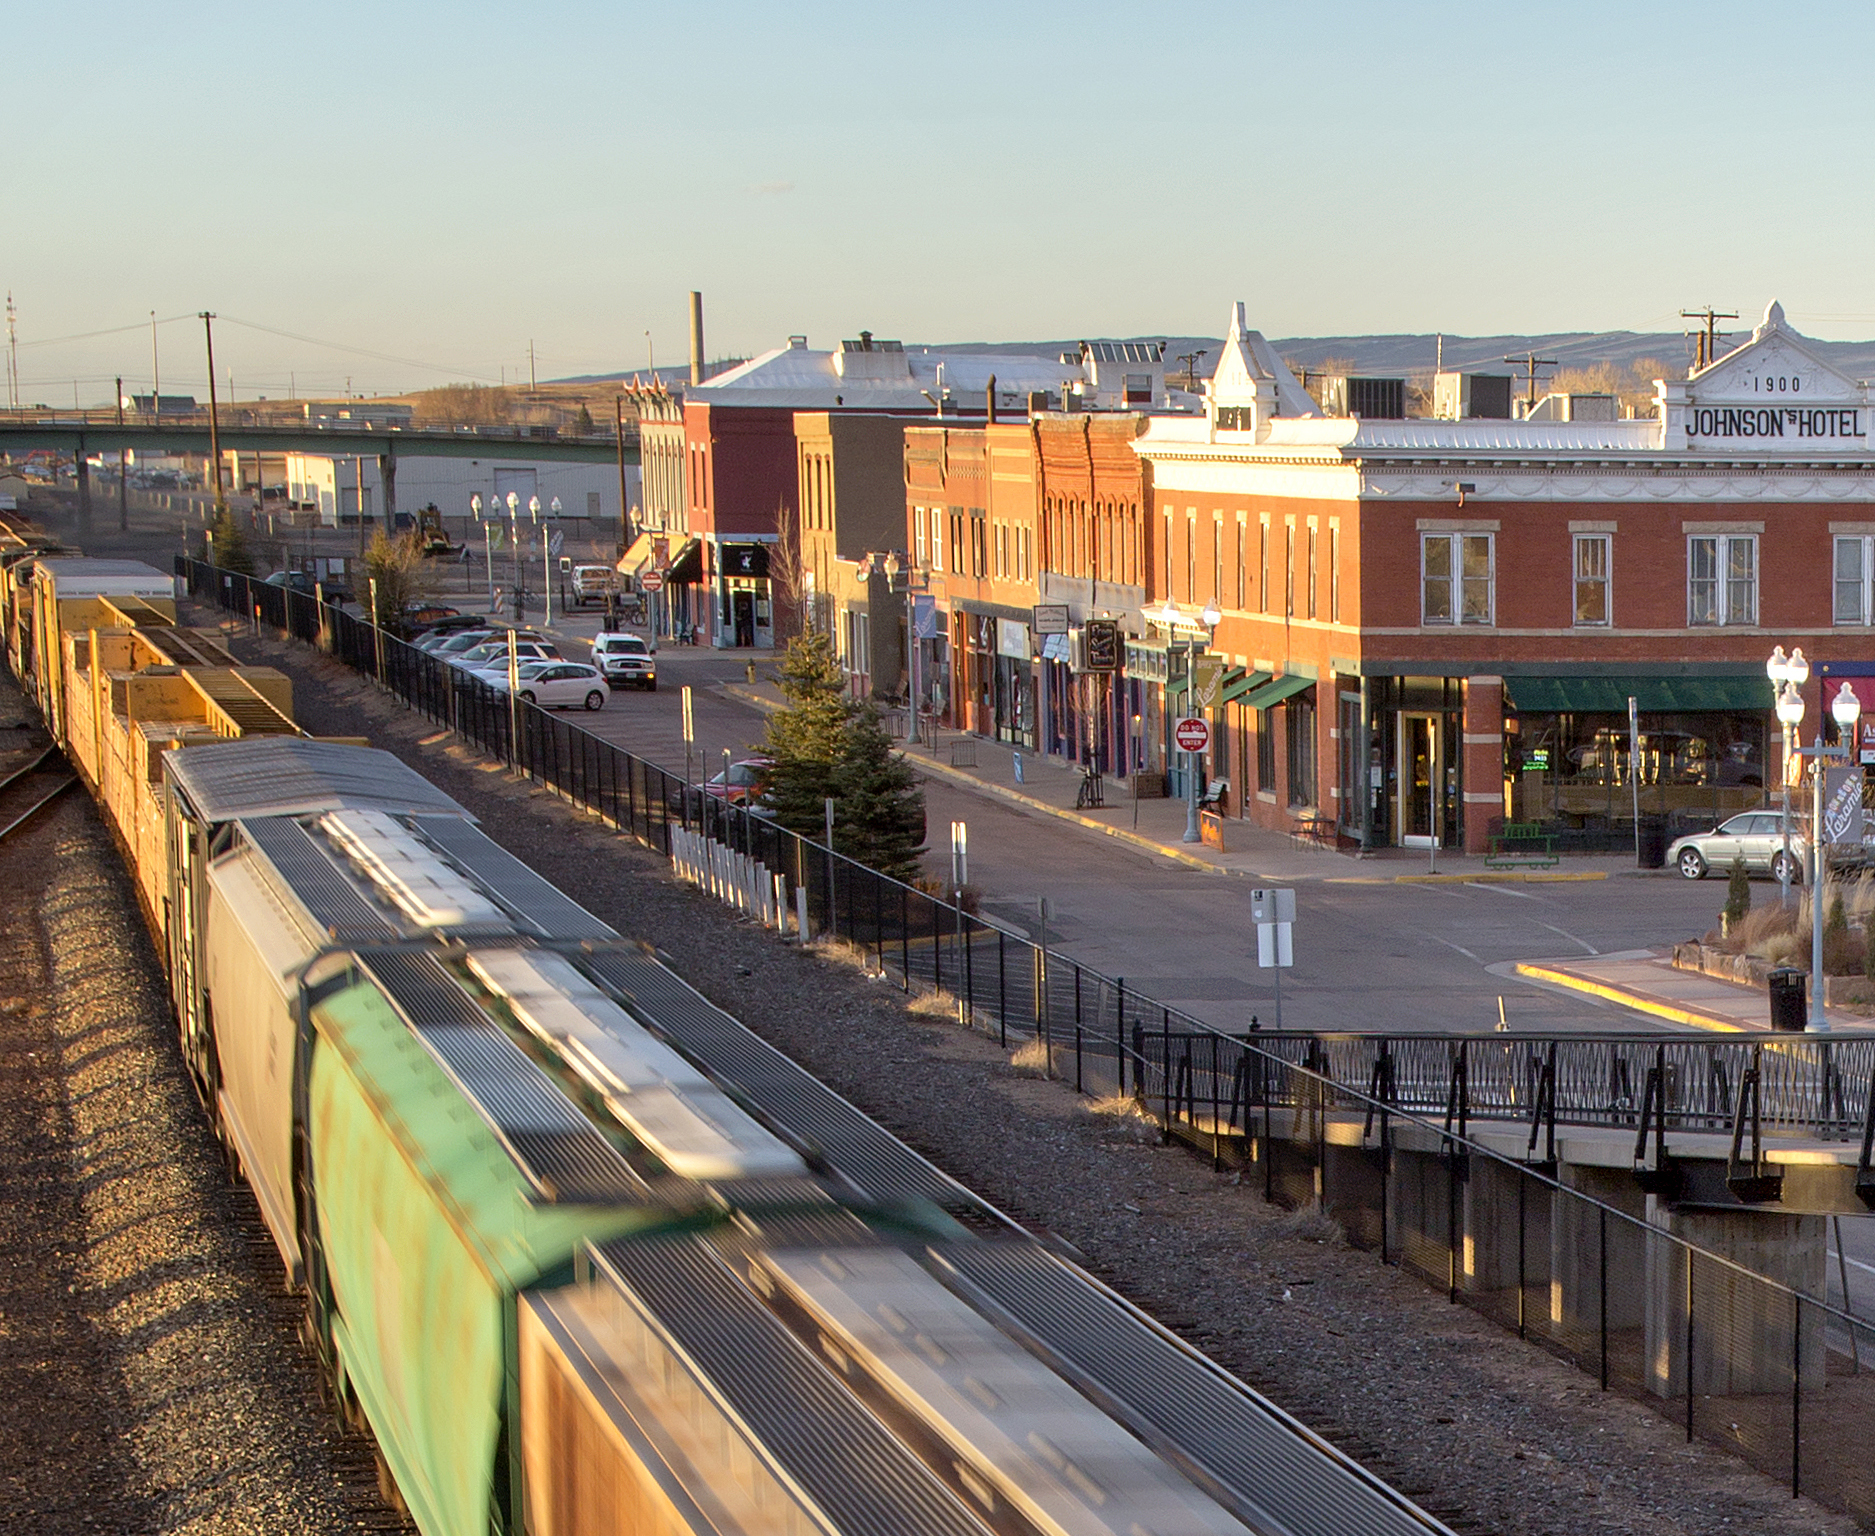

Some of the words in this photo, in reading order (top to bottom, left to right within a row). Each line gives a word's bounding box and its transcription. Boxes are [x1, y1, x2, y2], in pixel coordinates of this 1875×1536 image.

[1754, 376, 1800, 392] 1900
[1798, 409, 1866, 437] HOTEL
[1825, 782, 1863, 844] Laramie
